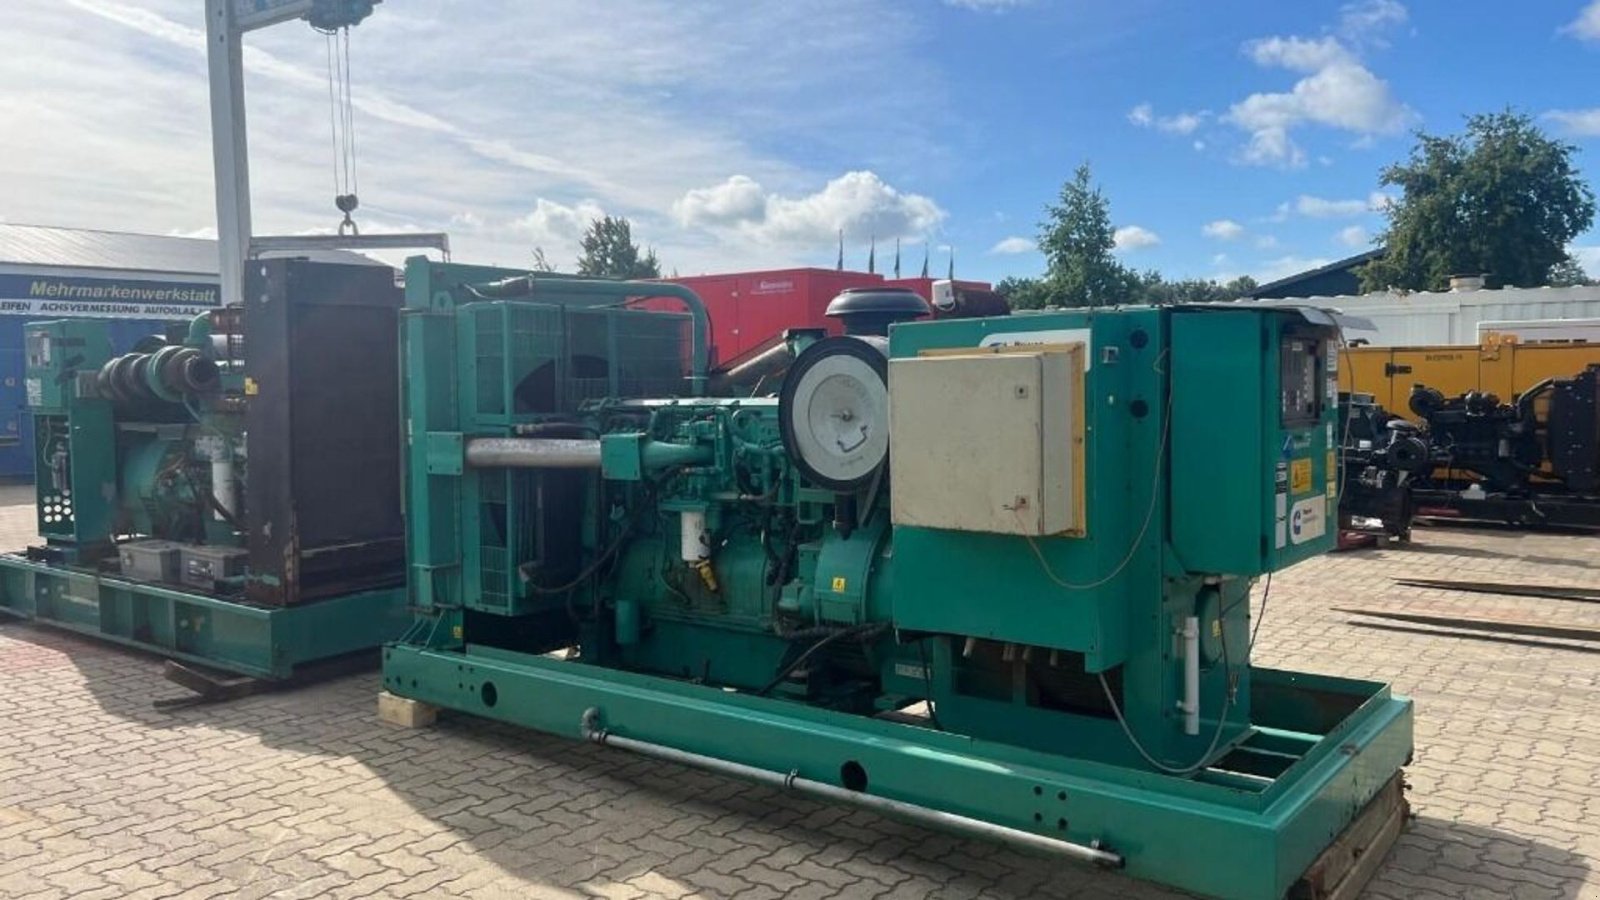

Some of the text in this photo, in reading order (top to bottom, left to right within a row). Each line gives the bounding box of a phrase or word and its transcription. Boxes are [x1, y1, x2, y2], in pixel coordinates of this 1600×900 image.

[30, 281, 215, 302] Mehrmarkenwerkstatt
[0, 301, 31, 311] EIFEN
[40, 303, 139, 314] ACHSVERMESSUNG
